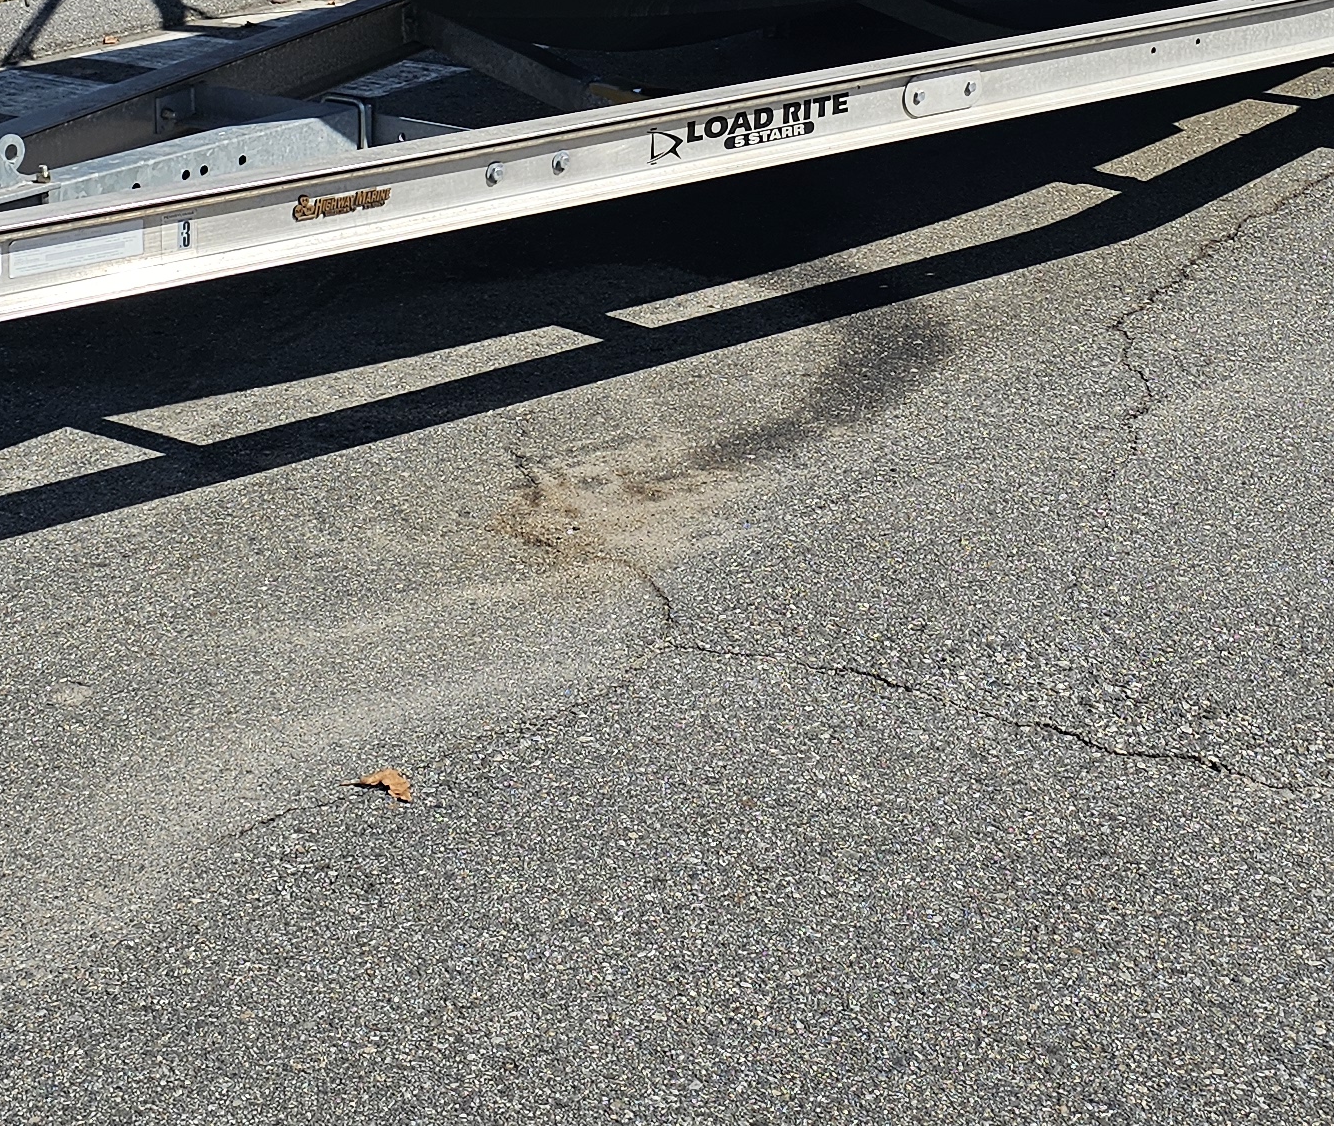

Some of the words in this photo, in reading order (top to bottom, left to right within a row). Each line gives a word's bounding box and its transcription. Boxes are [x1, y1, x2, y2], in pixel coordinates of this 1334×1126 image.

[686, 106, 775, 144] LOAD
[782, 91, 850, 125] RITE
[734, 135, 747, 148] 5
[747, 123, 806, 145] STARR
